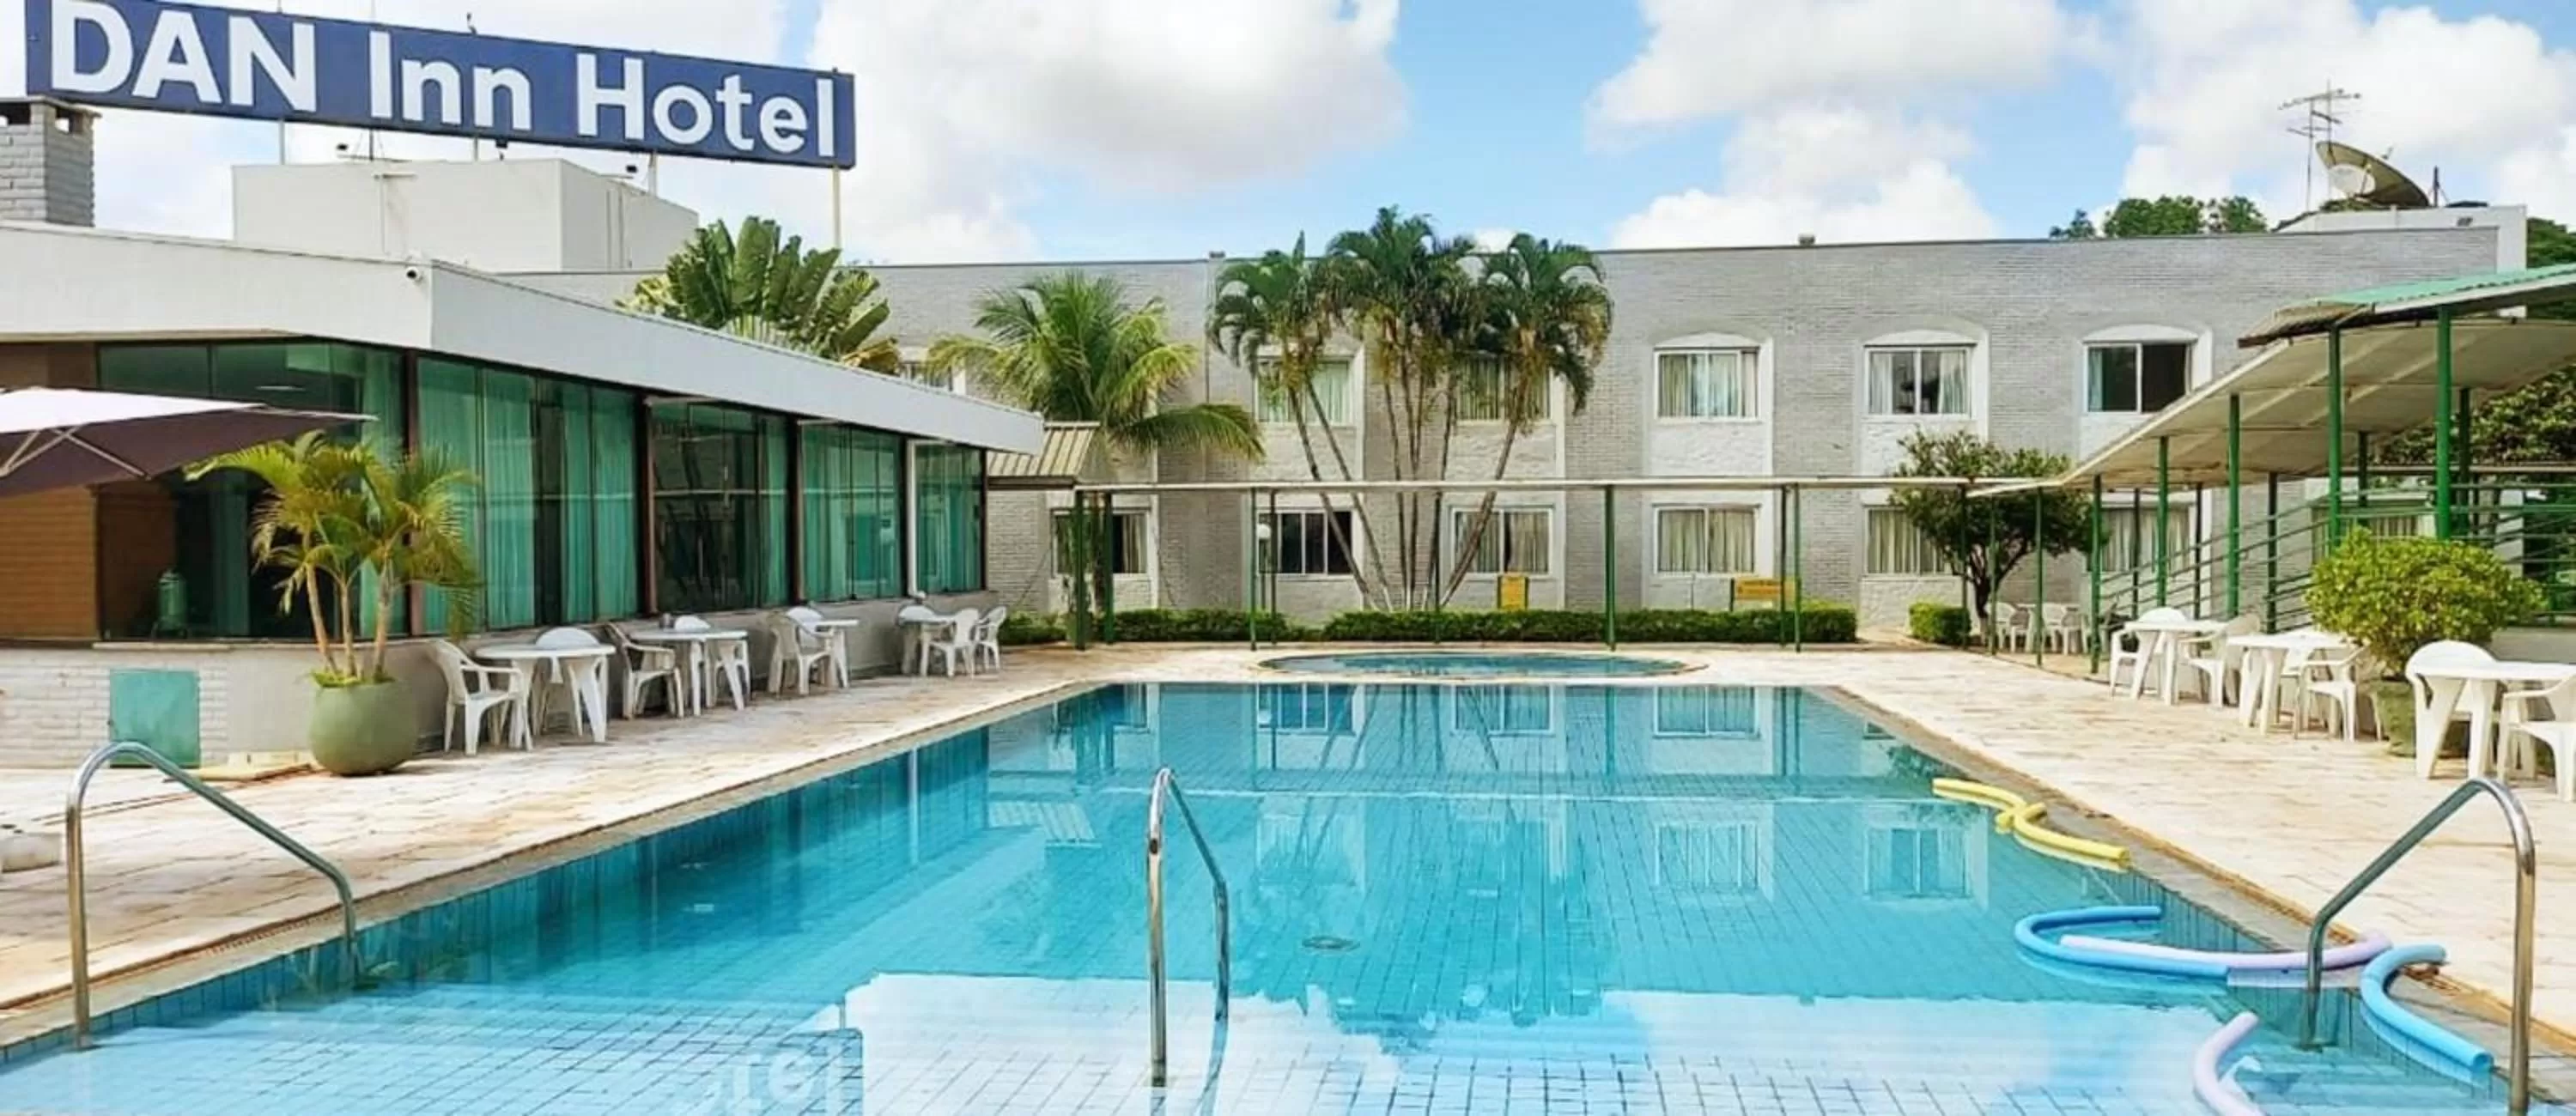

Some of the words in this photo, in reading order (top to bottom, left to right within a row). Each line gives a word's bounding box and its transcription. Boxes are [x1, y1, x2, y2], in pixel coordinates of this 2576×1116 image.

[52, 0, 317, 112] DAN
[369, 31, 532, 130] Inn
[577, 53, 834, 157] Hotel
